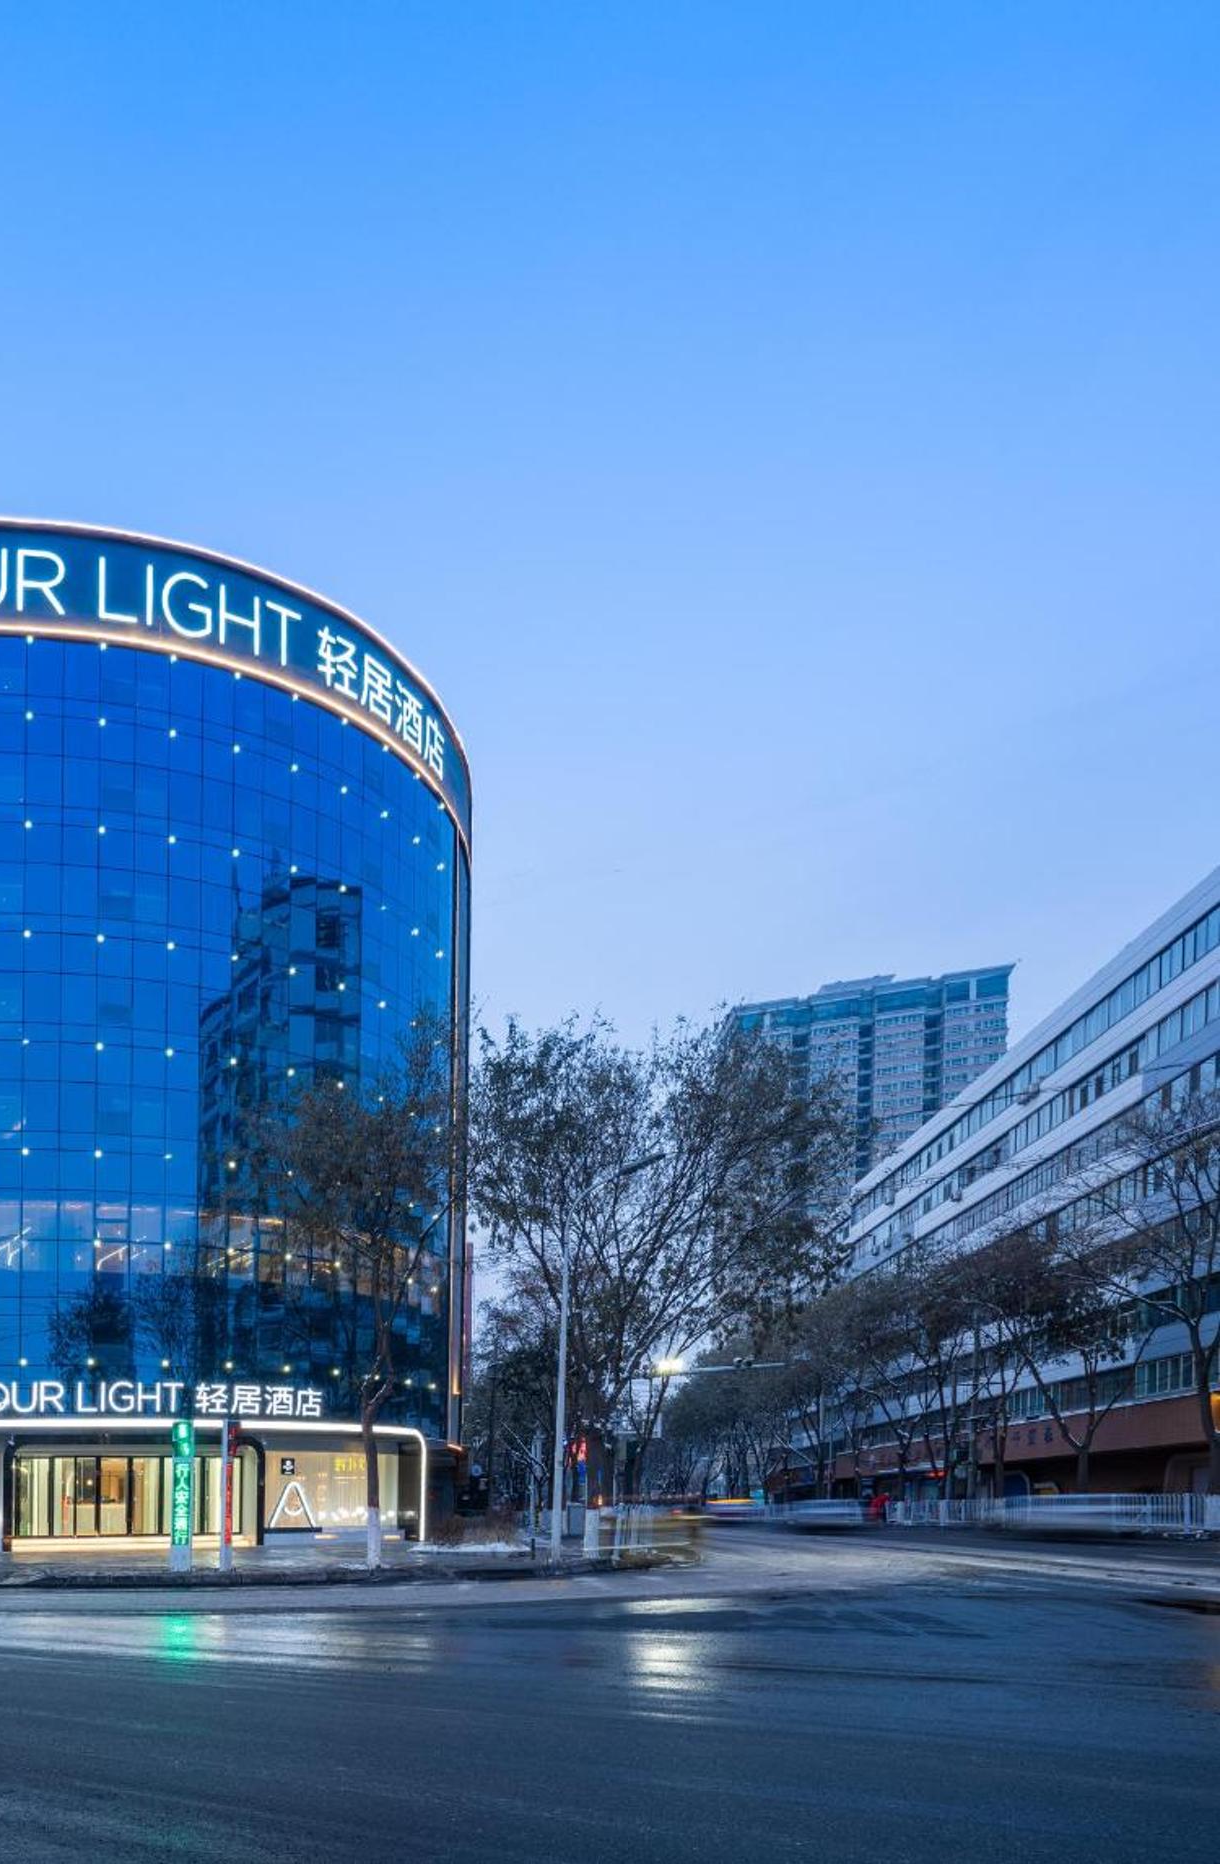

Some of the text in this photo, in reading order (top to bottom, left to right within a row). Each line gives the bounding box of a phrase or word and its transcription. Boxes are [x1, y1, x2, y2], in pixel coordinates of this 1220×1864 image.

[98, 555, 303, 667] LIGHT
[316, 625, 446, 782] 轻居酒店
[76, 1380, 185, 1414] LIGHT
[194, 1381, 323, 1418] 轻居酒店
[173, 1463, 191, 1546] 行人安全通行
